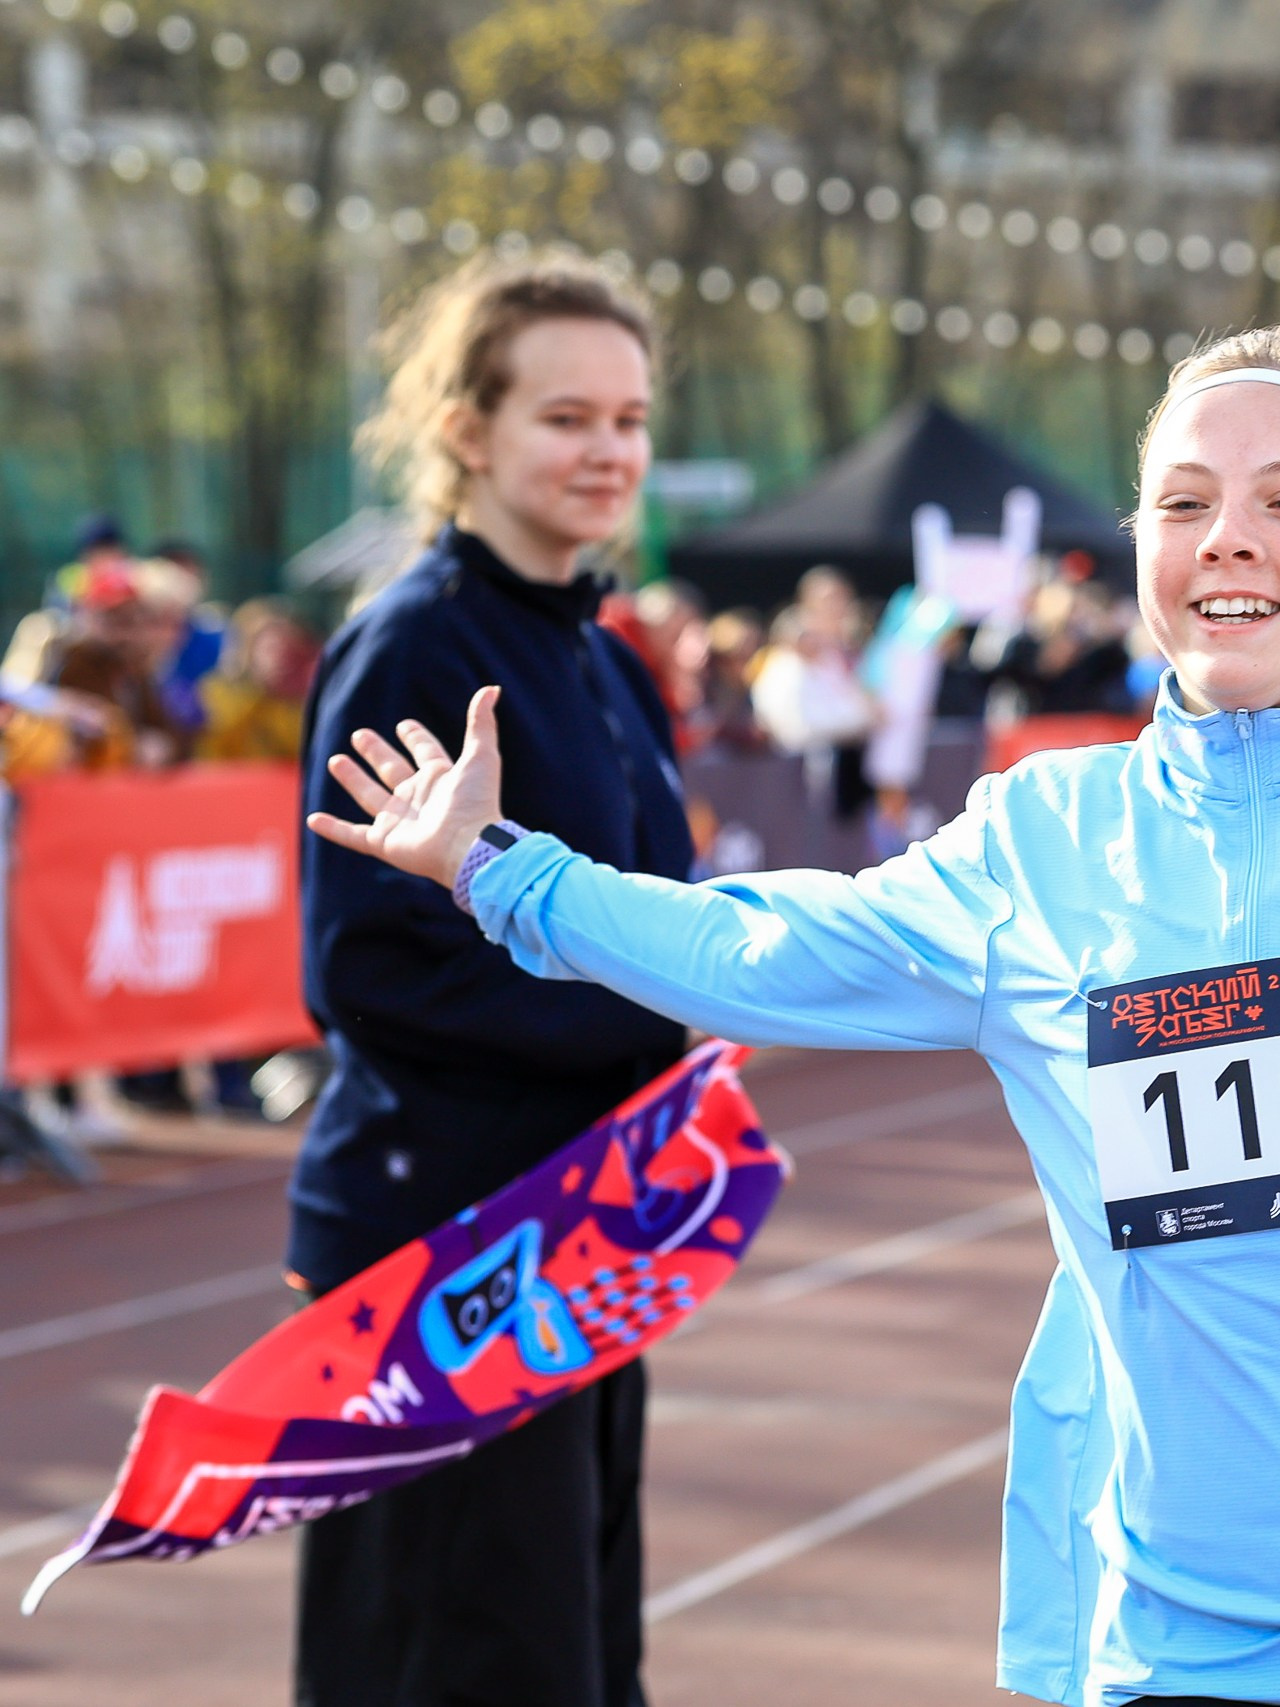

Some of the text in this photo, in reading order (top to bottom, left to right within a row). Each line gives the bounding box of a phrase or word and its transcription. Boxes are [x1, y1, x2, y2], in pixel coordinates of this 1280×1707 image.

[1112, 967, 1262, 1030] ДЕТСКИЙ
[1135, 1002, 1241, 1047] ЗАБЕГ
[1180, 1202, 1225, 1216] Департамент
